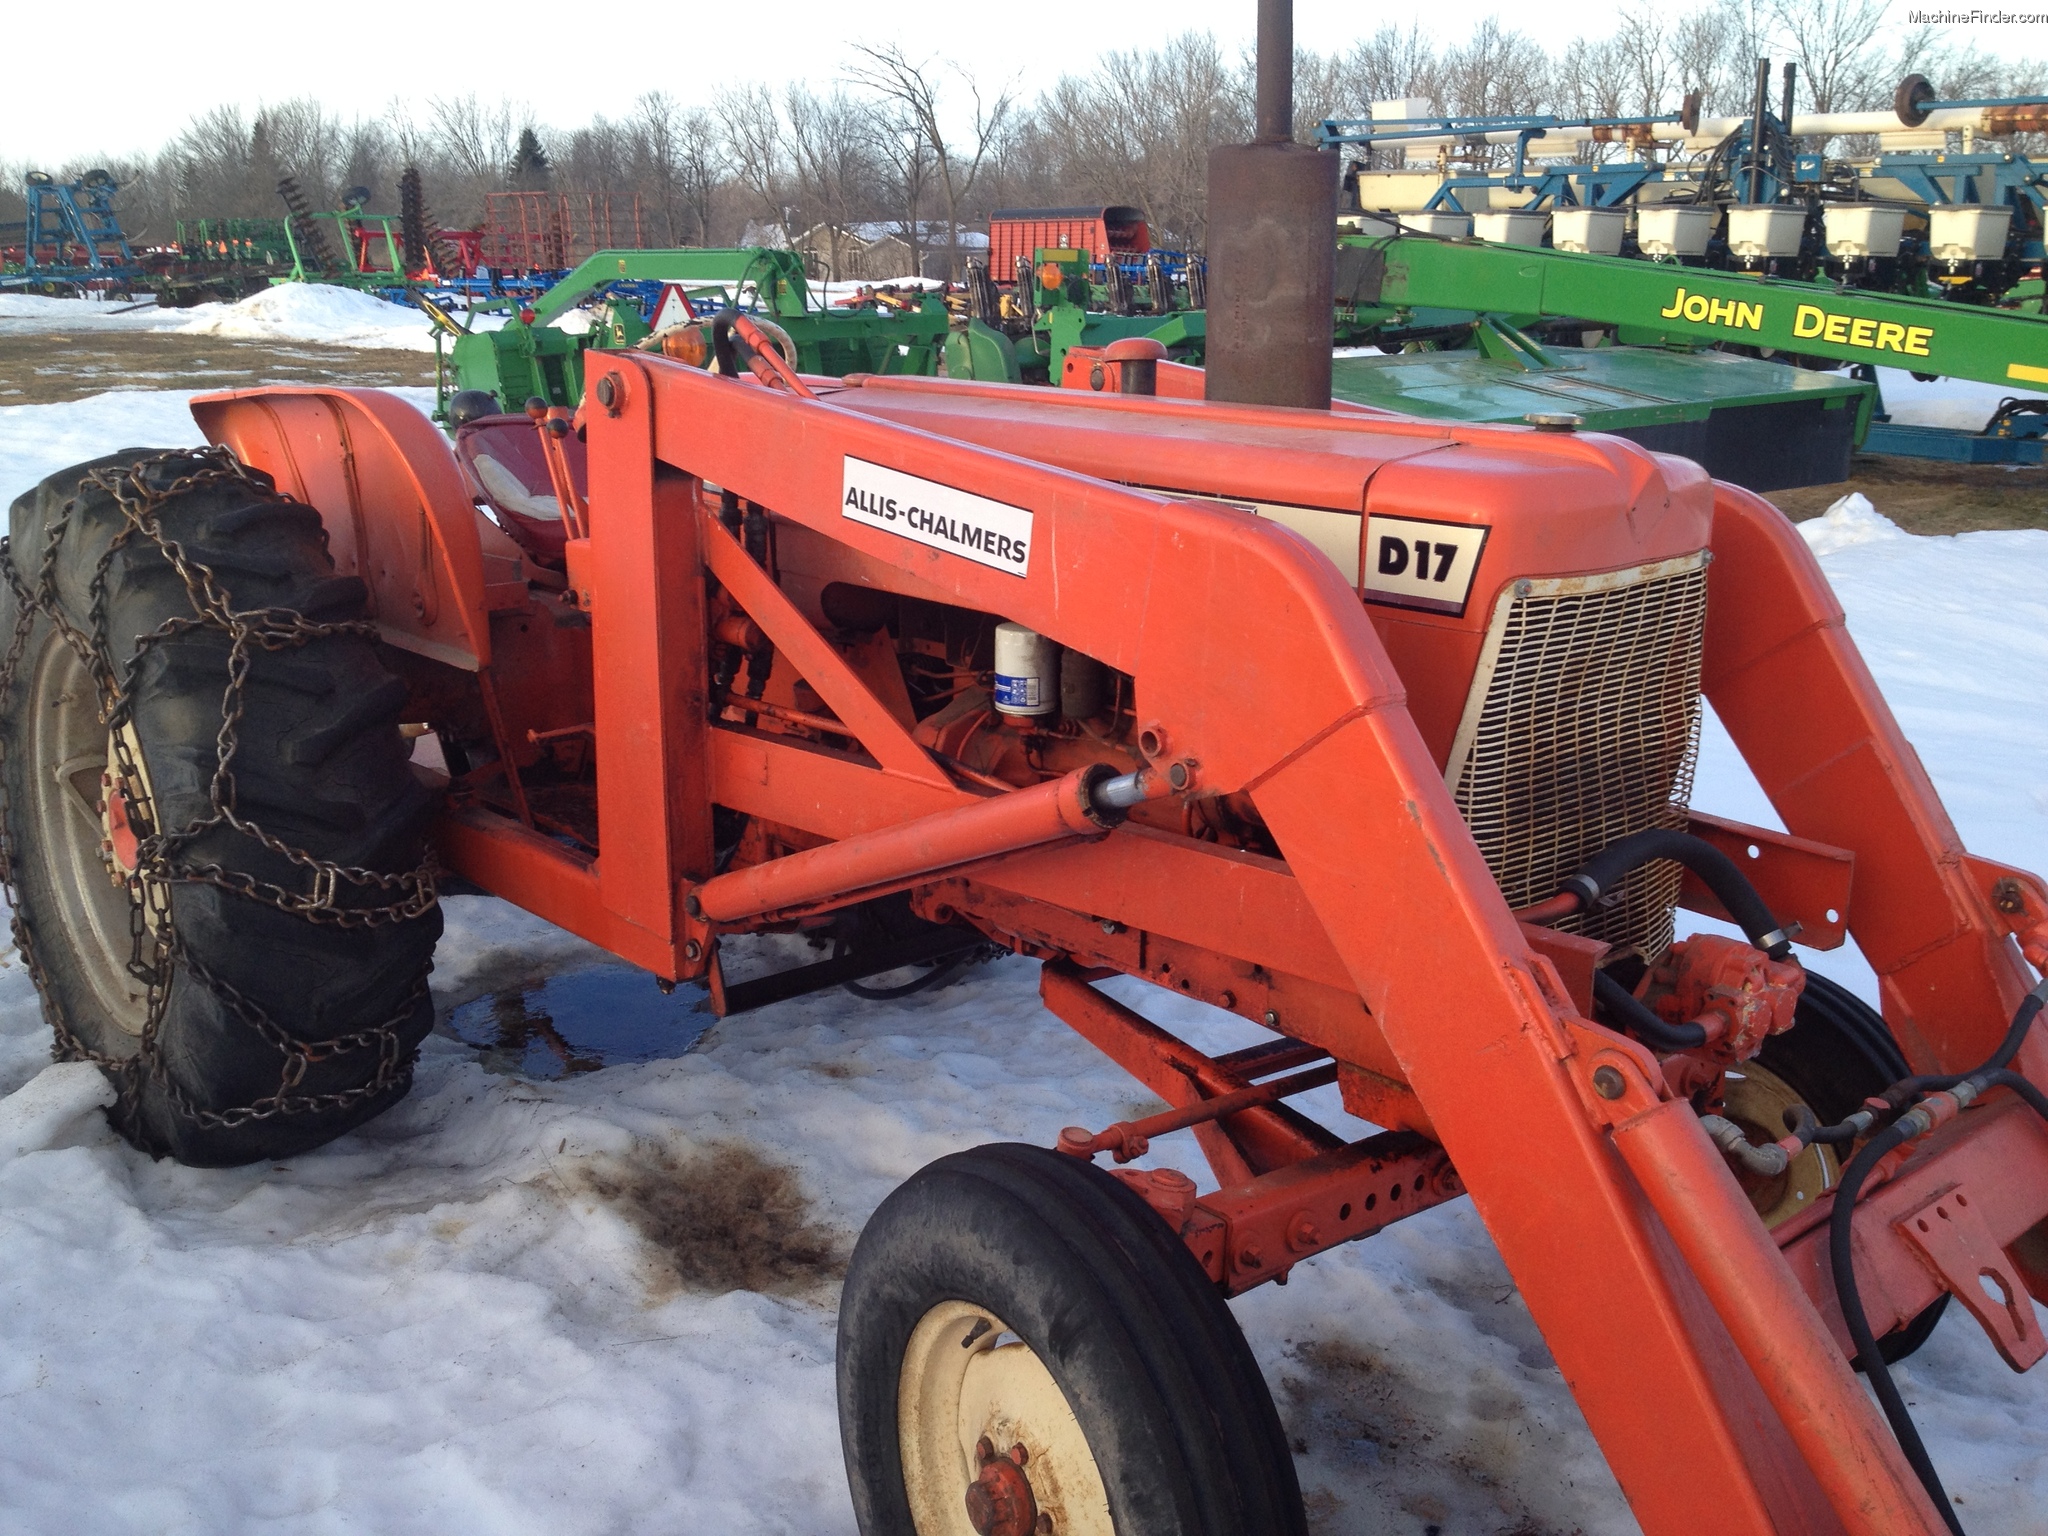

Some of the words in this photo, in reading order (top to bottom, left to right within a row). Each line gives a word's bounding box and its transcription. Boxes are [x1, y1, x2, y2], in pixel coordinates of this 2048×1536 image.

[1661, 287, 1764, 331] JOHN
[1793, 304, 1934, 357] DEERE
[844, 486, 1027, 564] ALLIS-CHALMERS
[1377, 535, 1459, 583] D17
